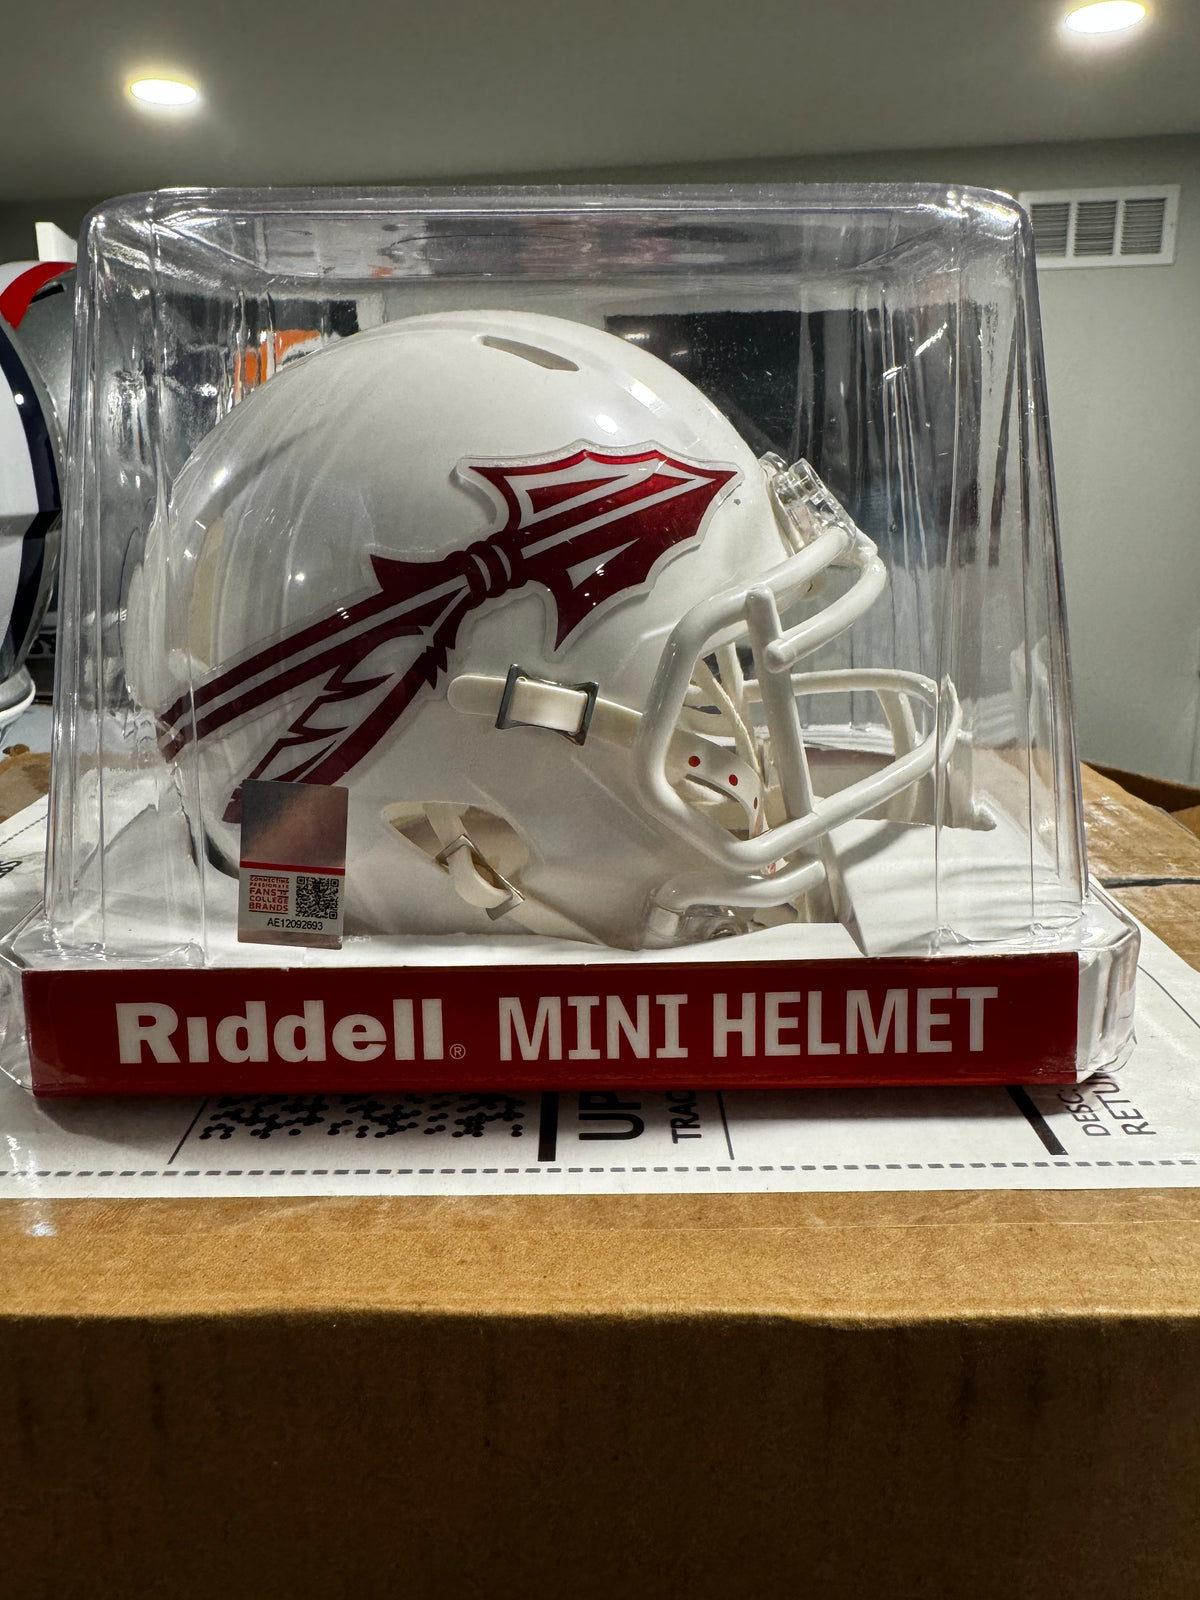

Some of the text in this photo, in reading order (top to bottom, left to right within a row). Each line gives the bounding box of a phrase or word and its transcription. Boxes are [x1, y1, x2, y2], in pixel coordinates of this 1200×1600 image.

[250, 887, 276, 896] FANS
[250, 895, 288, 904] COLLEGE
[249, 902, 288, 912] BRANDS
[267, 918, 323, 930] AE12092693
[499, 993, 689, 1061] MINI
[713, 986, 999, 1058] HELMET
[1089, 1072, 1157, 1136] RETU
